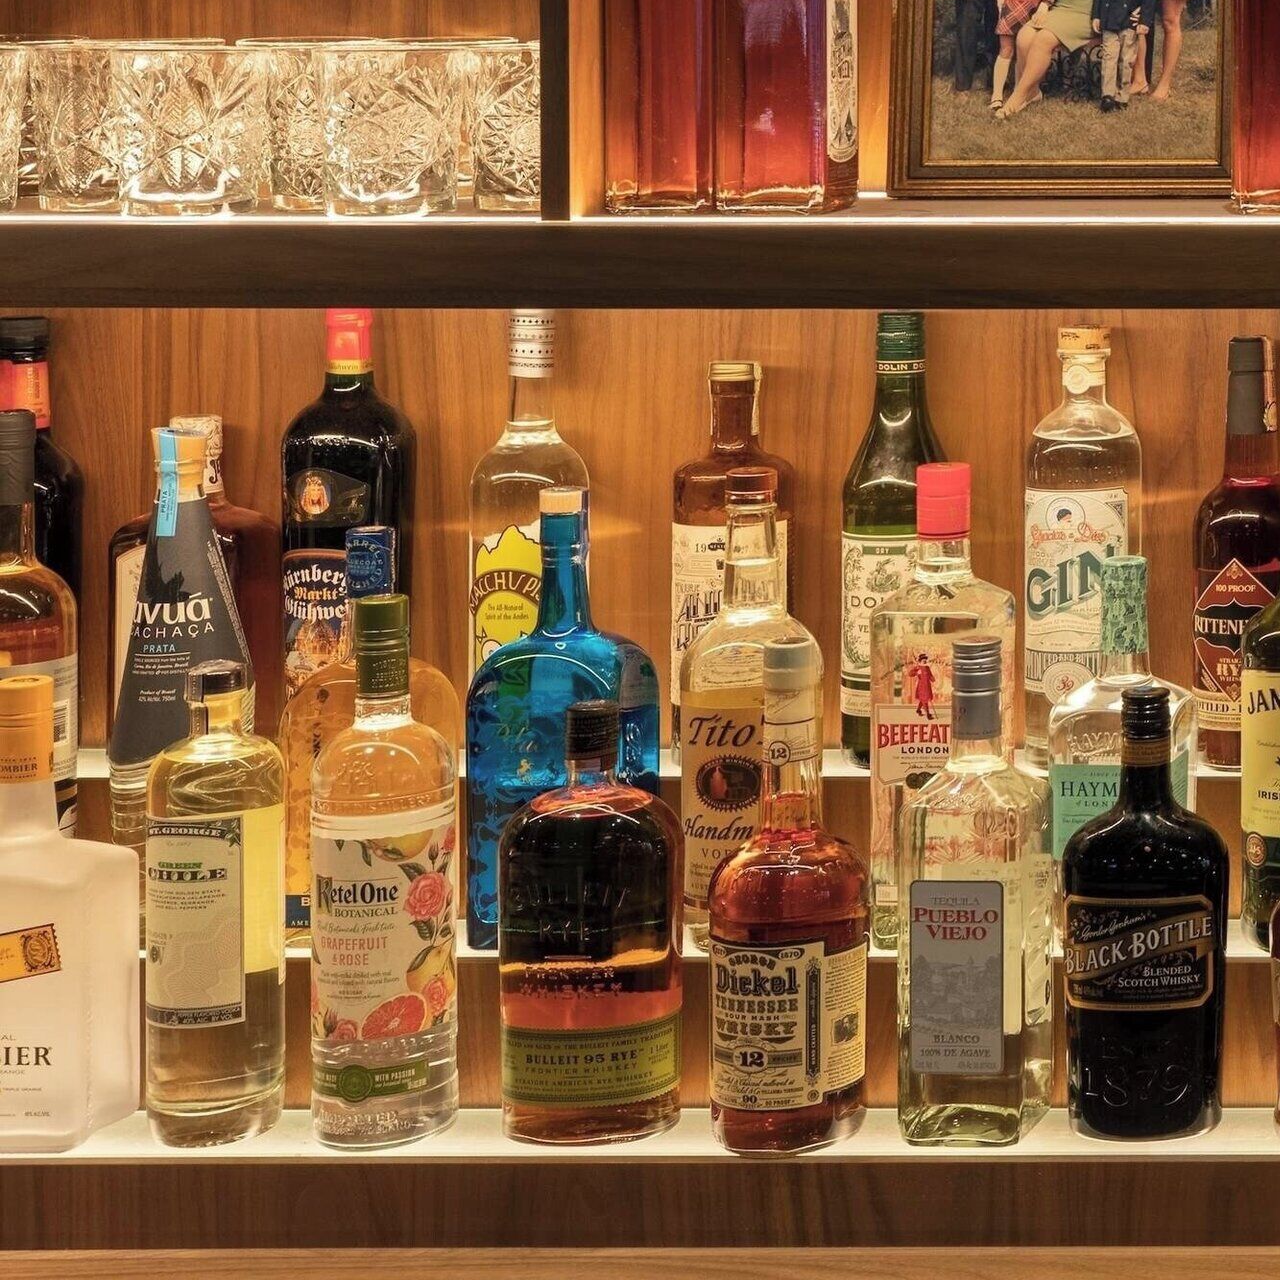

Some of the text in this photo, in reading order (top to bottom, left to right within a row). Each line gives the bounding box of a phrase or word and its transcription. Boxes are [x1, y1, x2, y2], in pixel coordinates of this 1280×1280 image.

[1027, 544, 1115, 617] GIN
[1215, 584, 1255, 592] 100 PROOF
[143, 644, 175, 652] PRATA
[770, 746, 786, 759] 12
[901, 746, 949, 754] LONDON
[162, 827, 222, 837] GEORGE
[316, 873, 399, 916] Ketel One
[930, 897, 980, 906] TEQUILA
[335, 907, 399, 918] BOTANICAL
[914, 907, 998, 923] PUEBLO
[926, 924, 987, 941] VIEJO
[321, 937, 388, 950] GRAPEFRUIT
[1064, 915, 1213, 975] BLACK BOTTLE
[340, 954, 369, 965] ROSE
[729, 954, 777, 970] GEORGE
[1143, 965, 1191, 977] BLENDED
[715, 965, 798, 996] Dickel
[1118, 973, 1201, 988] SCOTCH WHISKY
[715, 995, 798, 1014] TENNESSEE
[715, 1016, 797, 1036] WHISKY
[933, 1034, 980, 1044] BLANCO
[526, 1050, 638, 1065] BULLEIT 95 RYE
[739, 1051, 764, 1067] 12
[921, 1048, 991, 1057] 100% DE AGAVE
[742, 1095, 757, 1104] 90
